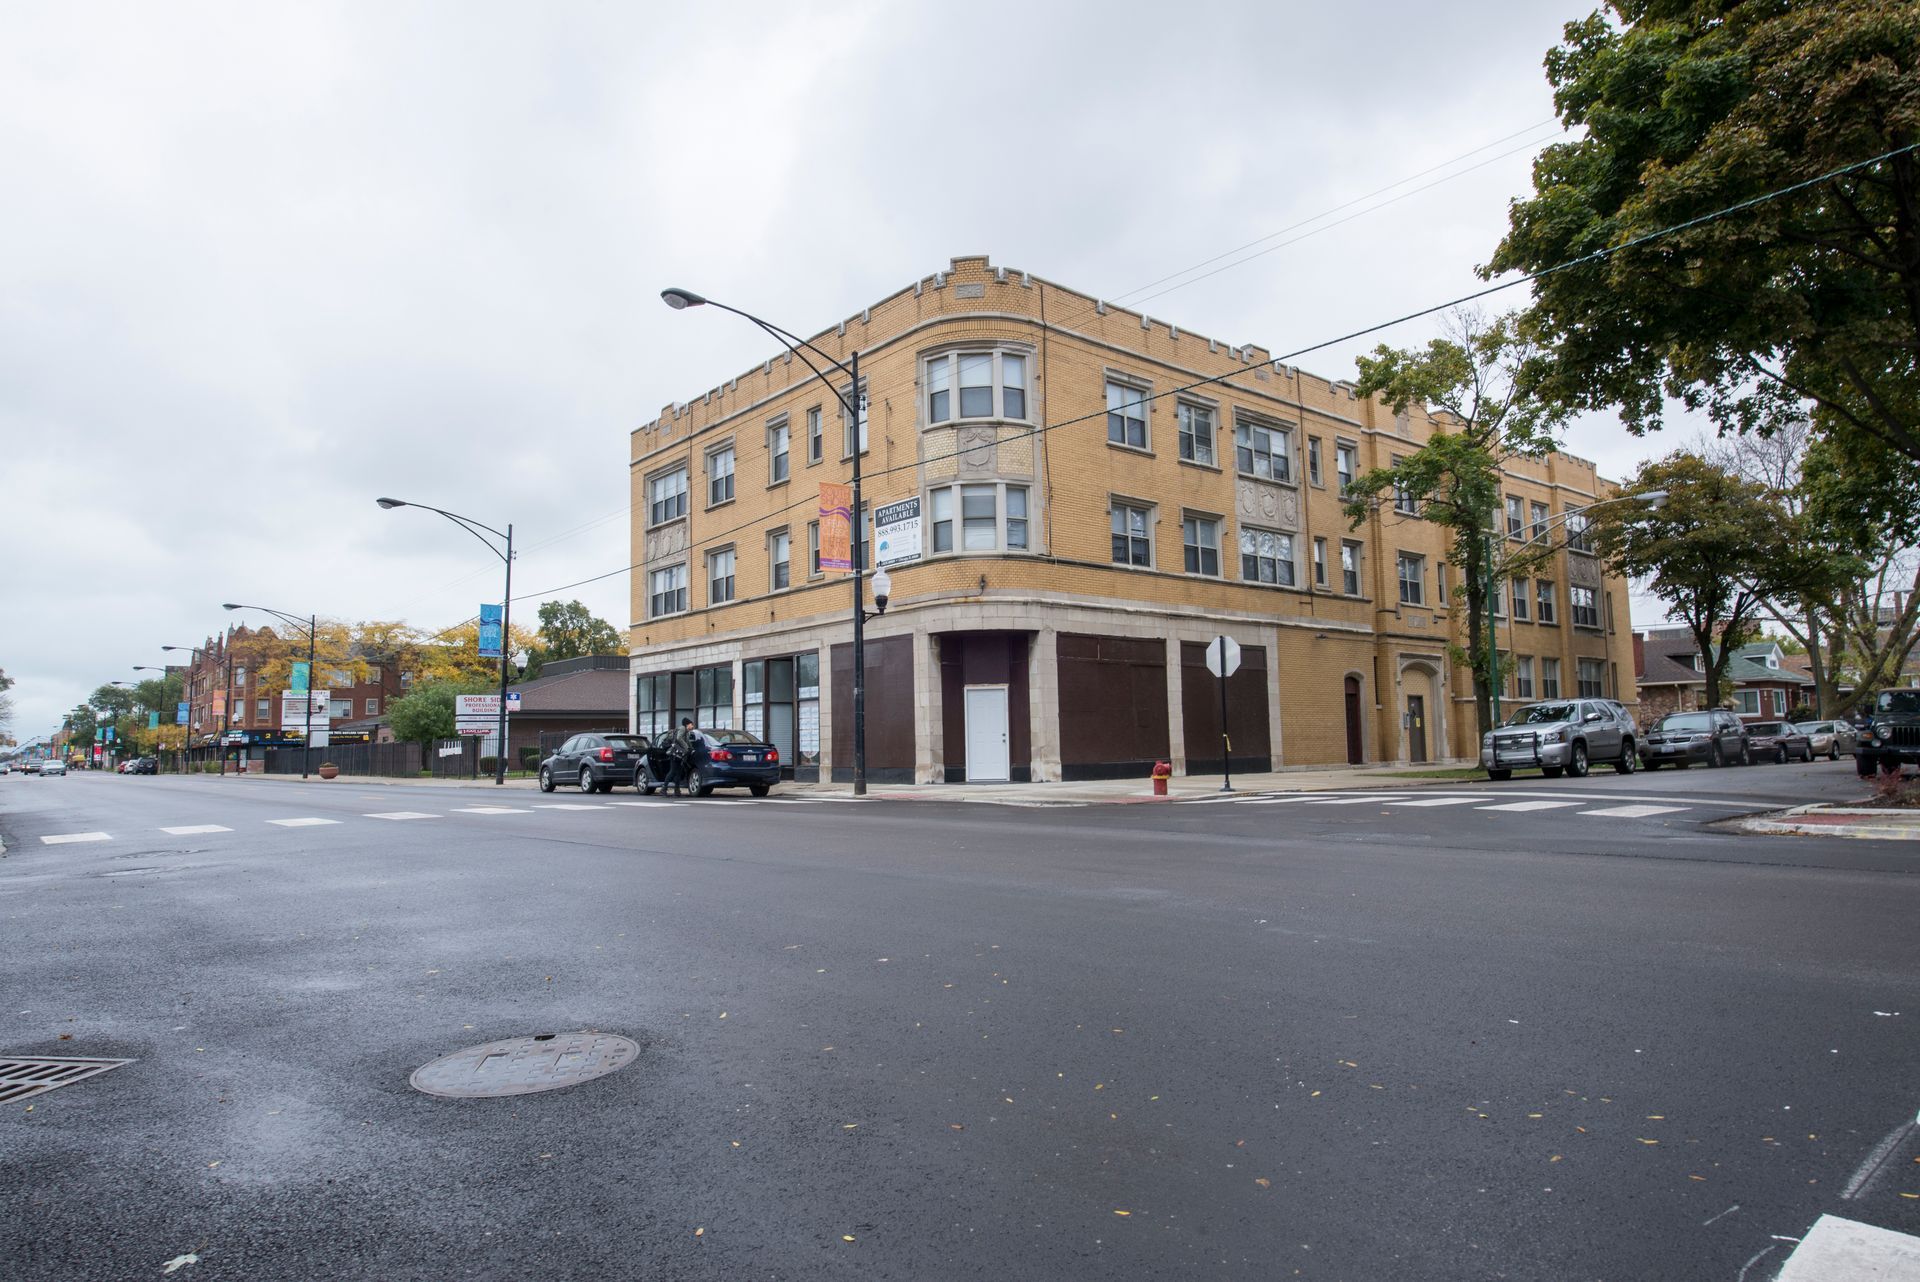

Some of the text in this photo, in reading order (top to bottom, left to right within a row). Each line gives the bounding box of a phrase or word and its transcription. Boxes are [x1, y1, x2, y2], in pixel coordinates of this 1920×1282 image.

[878, 500, 918, 518] APARTMENTS
[881, 508, 914, 525] AVAILABLE
[877, 520, 919, 538] 888.993.1715
